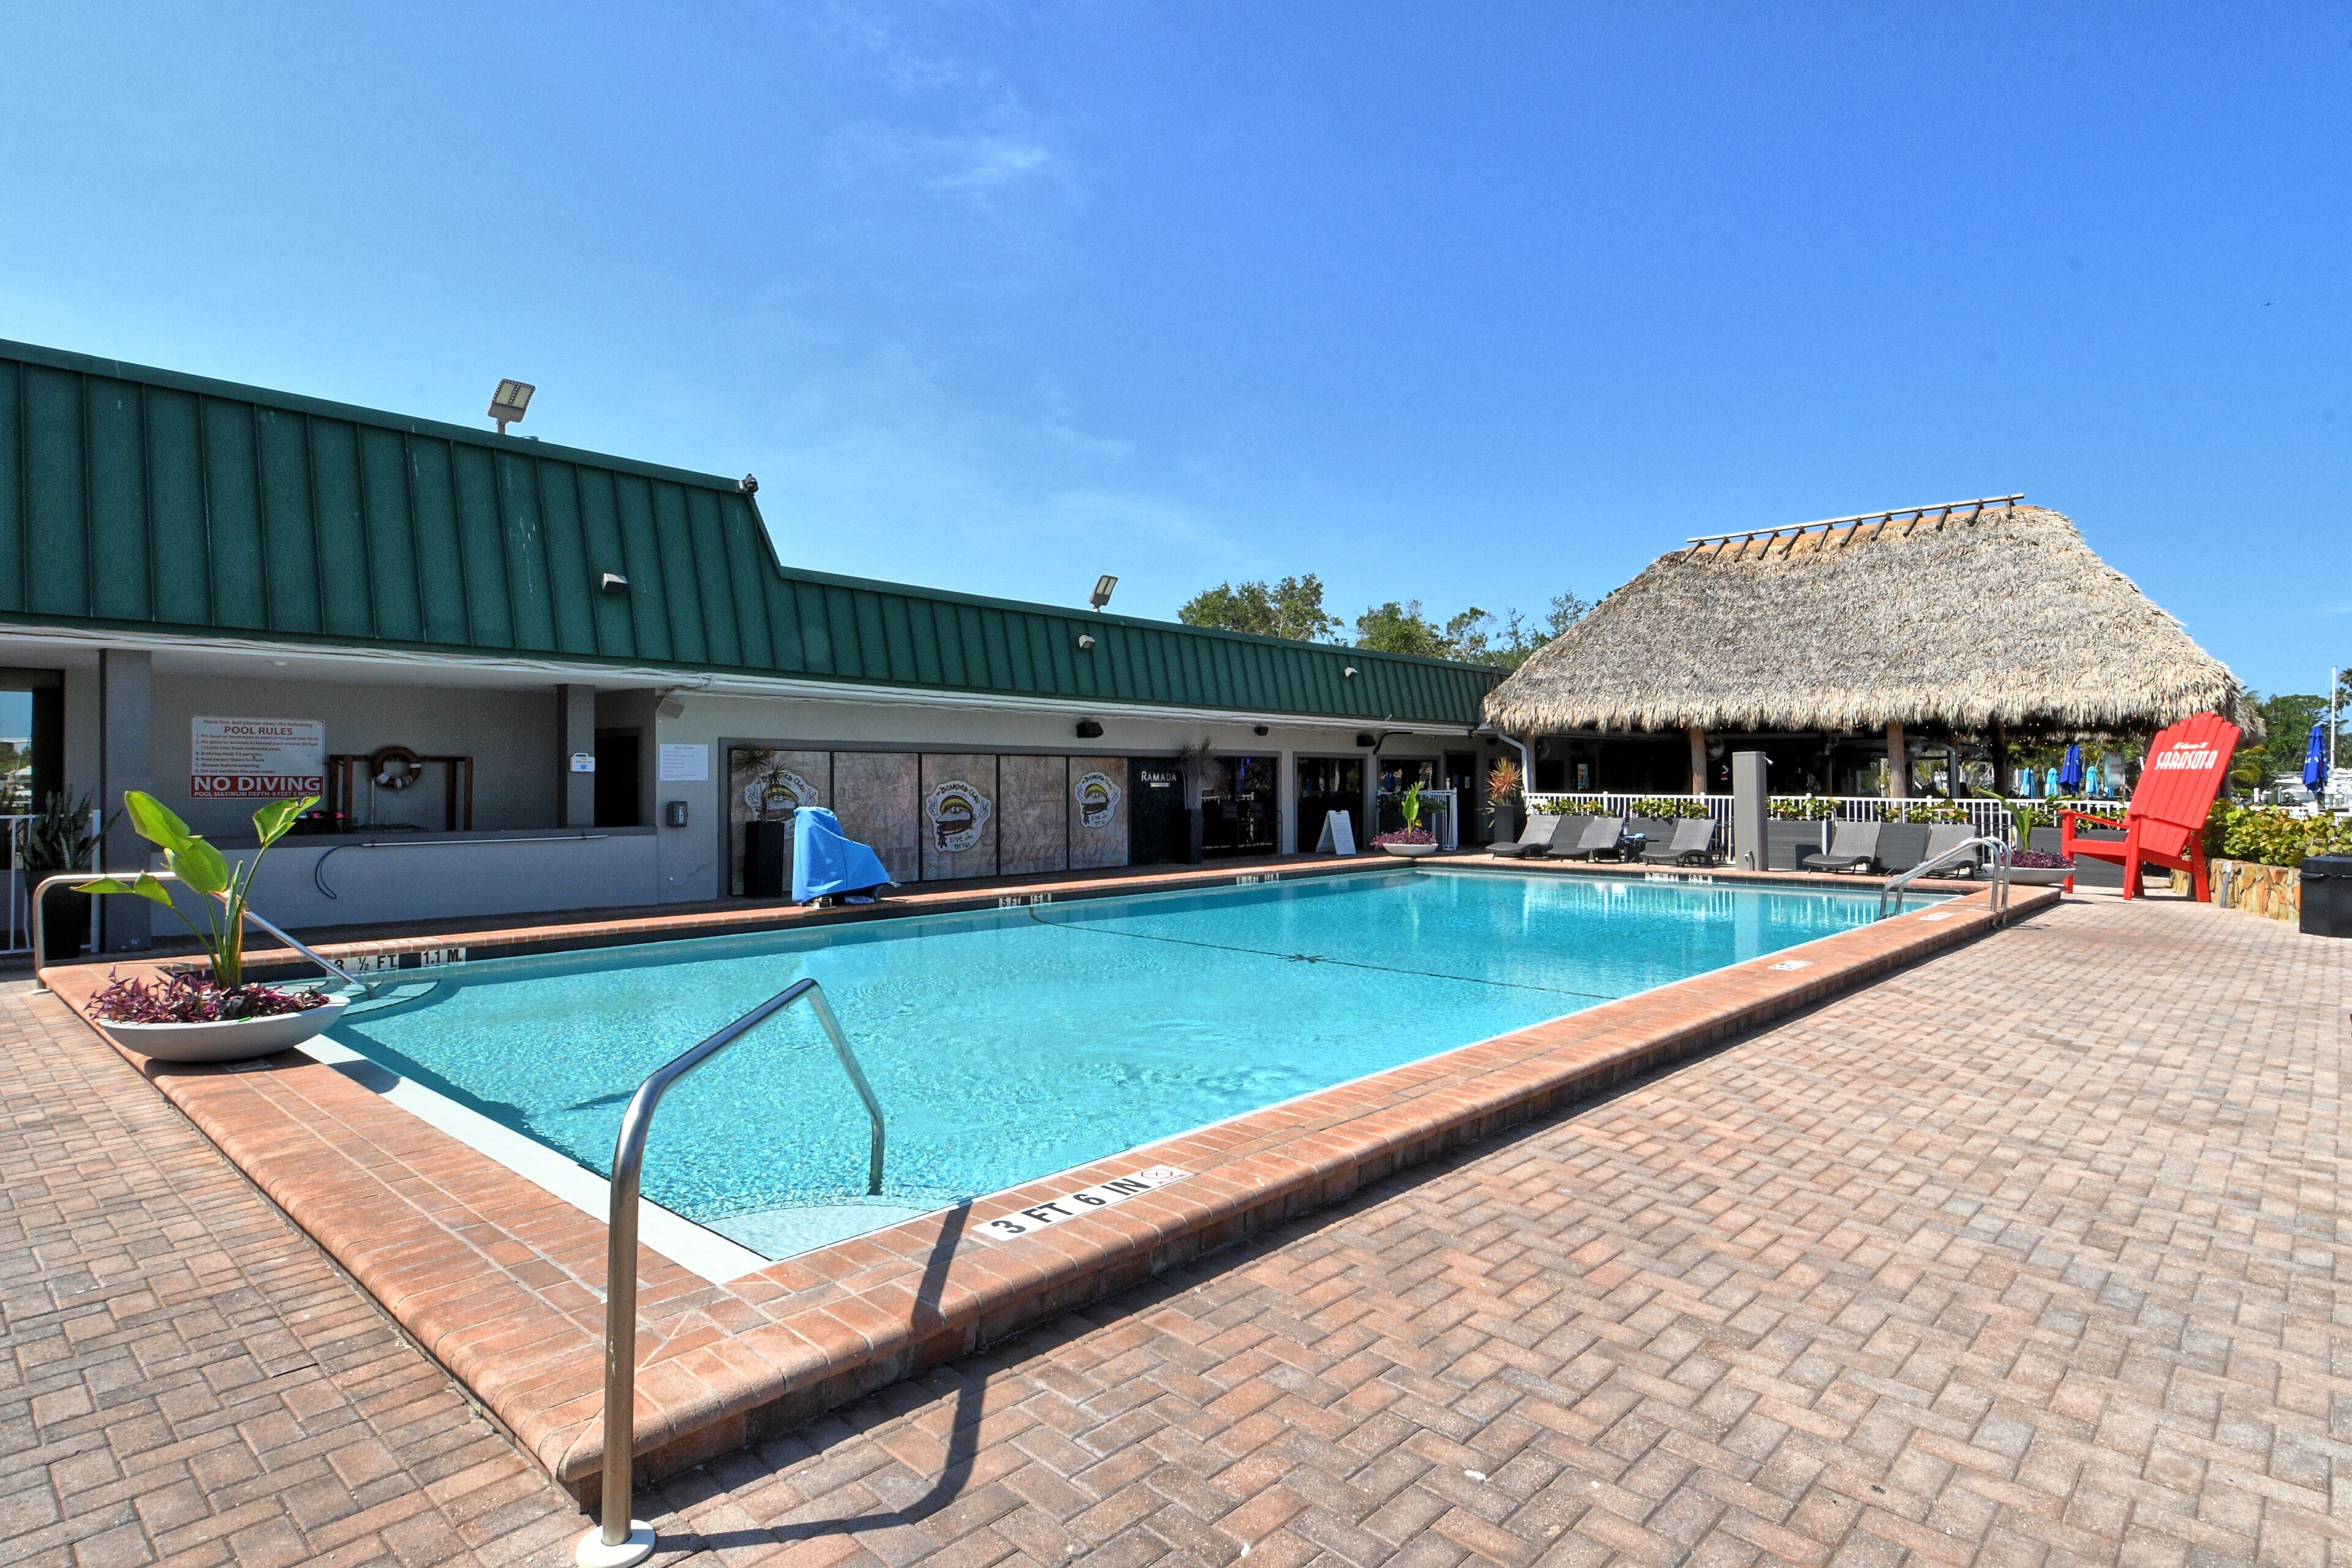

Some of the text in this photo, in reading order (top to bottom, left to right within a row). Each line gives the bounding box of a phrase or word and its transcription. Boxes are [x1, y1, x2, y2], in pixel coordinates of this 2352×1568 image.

[224, 726, 293, 736] POOL RULES
[2154, 750, 2218, 770] SARASOTA
[194, 777, 320, 791] NO DIVING
[1002, 897, 1007, 907] 5
[334, 959, 344, 971] 3
[990, 1178, 1152, 1234] 3 FT 6 IN
